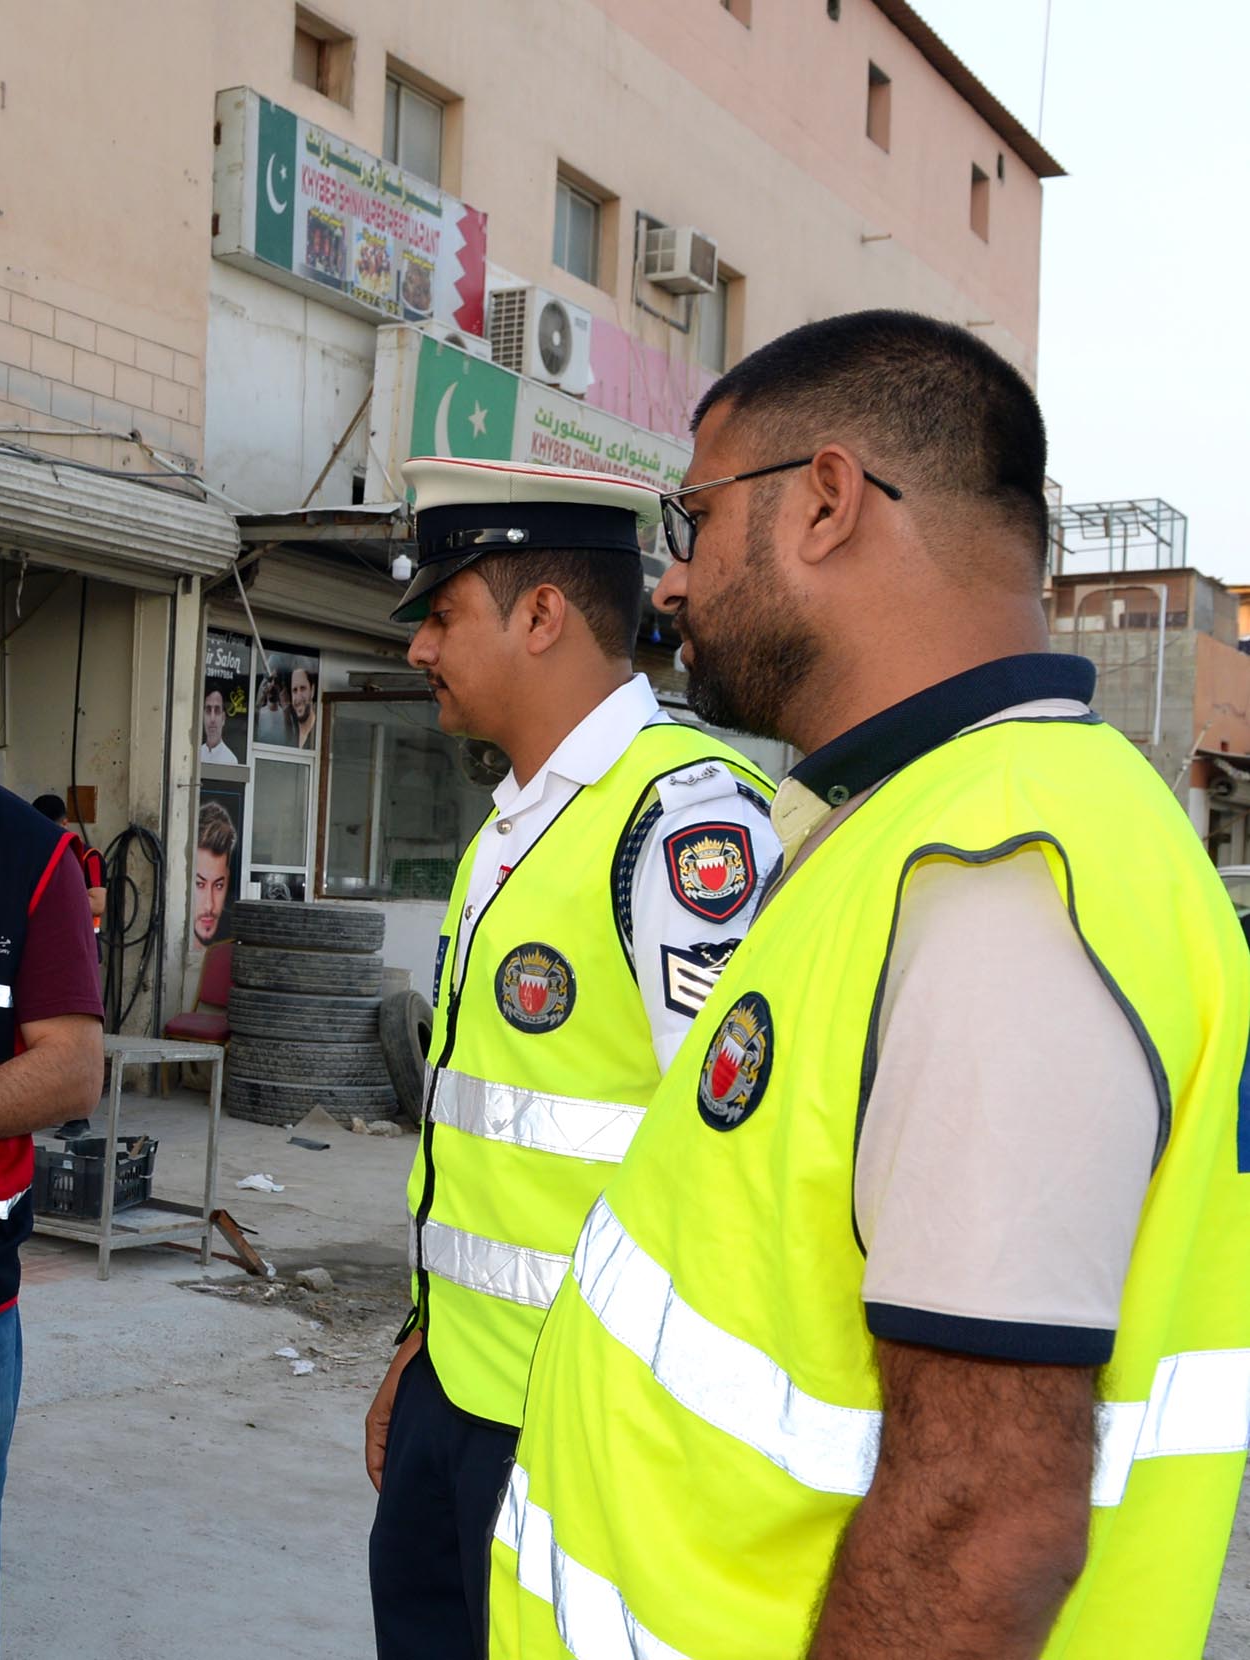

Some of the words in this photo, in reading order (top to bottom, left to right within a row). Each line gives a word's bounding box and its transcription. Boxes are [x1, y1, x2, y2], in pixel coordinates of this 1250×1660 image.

[302, 163, 337, 206] KHYBER
[531, 431, 572, 466] KHYBER
[215, 648, 241, 674] Salon
